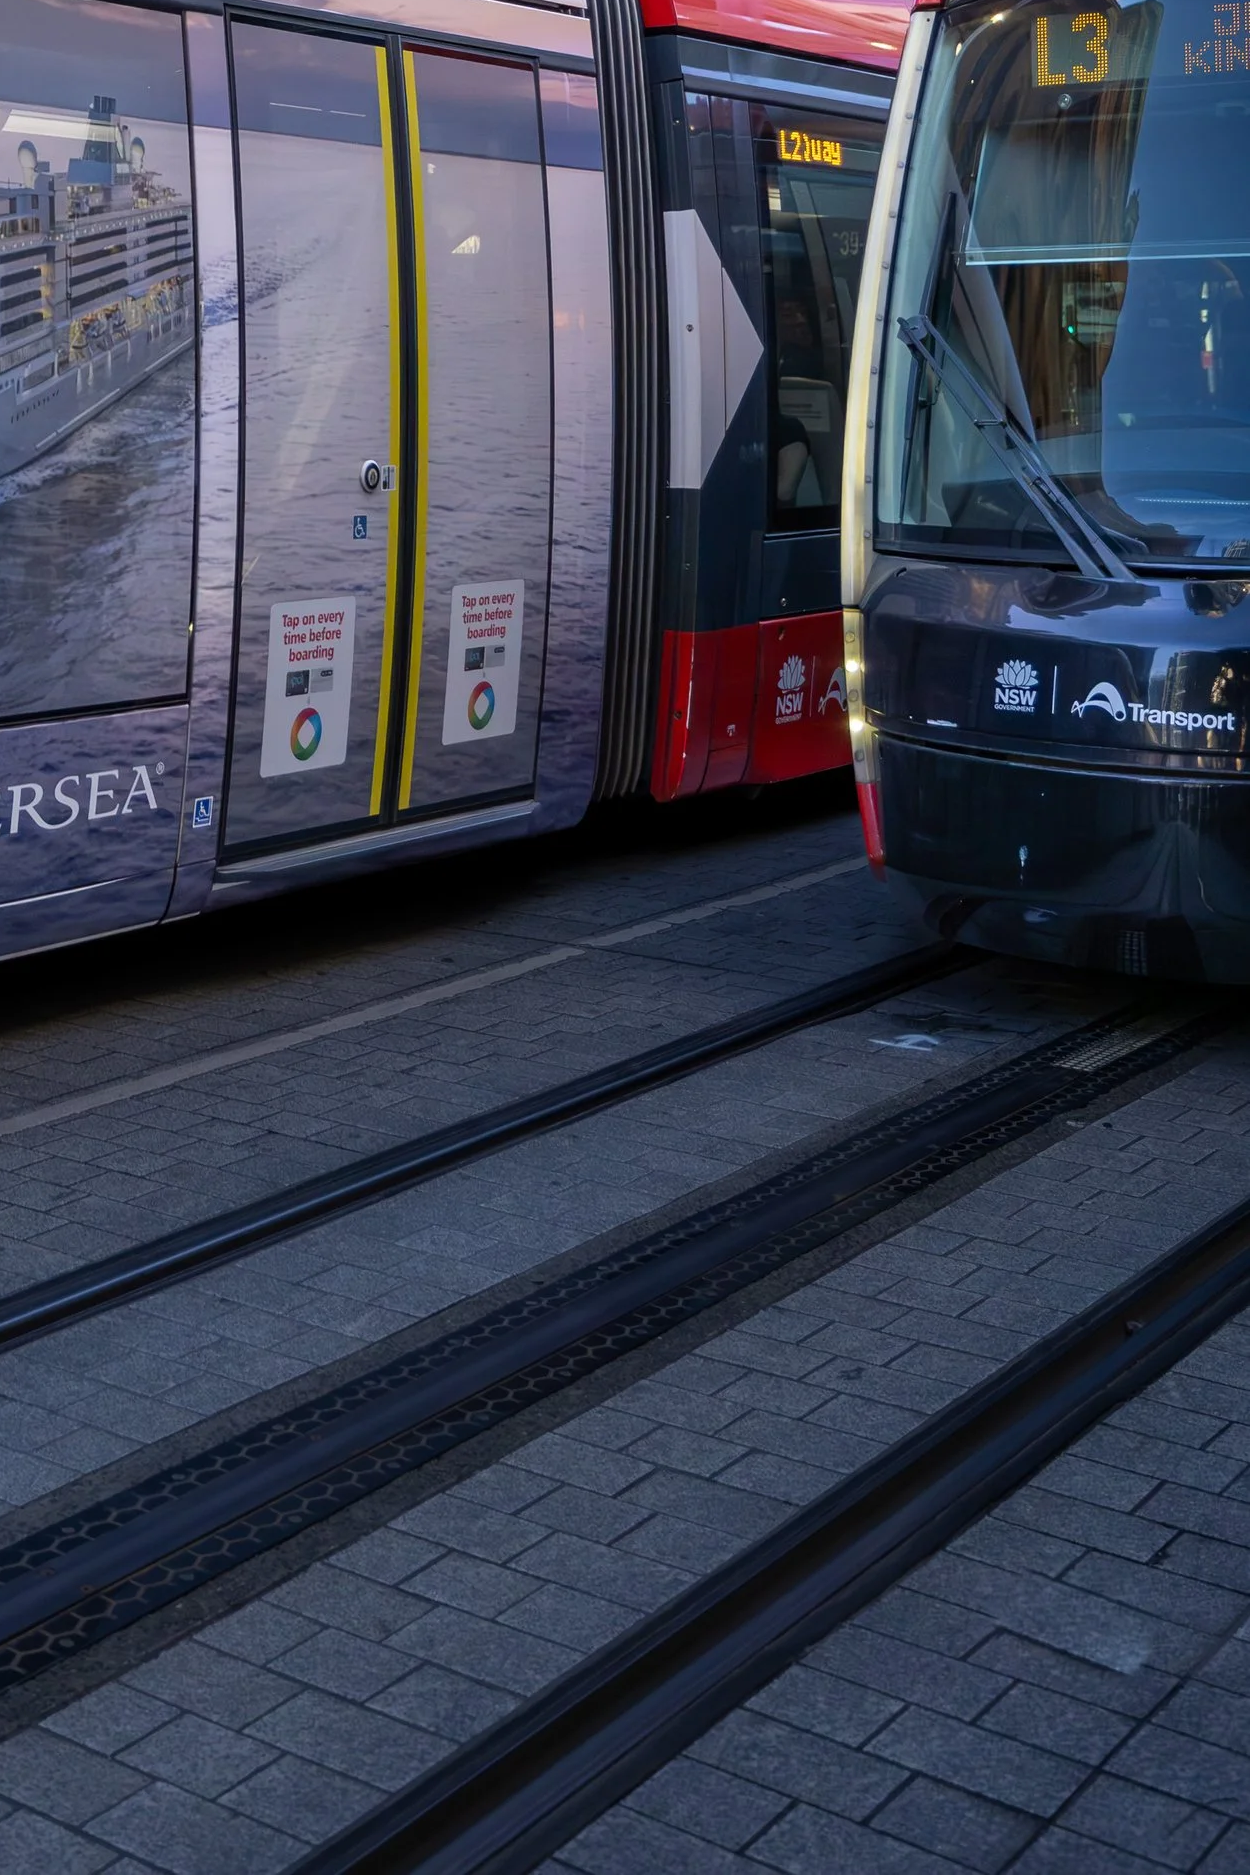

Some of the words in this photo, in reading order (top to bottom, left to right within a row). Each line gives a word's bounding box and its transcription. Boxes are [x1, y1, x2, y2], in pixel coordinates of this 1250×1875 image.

[1036, 12, 1109, 86] L3
[780, 130, 802, 160] L2
[462, 595, 477, 610] Tap
[478, 595, 490, 606] on
[492, 592, 515, 607] every
[282, 614, 300, 629] Tap
[302, 613, 315, 626] on
[318, 610, 345, 625] every
[462, 611, 483, 624] time
[484, 607, 513, 622] before
[283, 631, 306, 645] time
[309, 627, 342, 643] before
[467, 624, 506, 639] boarding
[289, 645, 335, 662] boarding
[776, 692, 804, 717] NSW
[994, 687, 1037, 706] NSW
[994, 703, 1035, 713] GOVERNMENT
[1128, 703, 1235, 731] Transport
